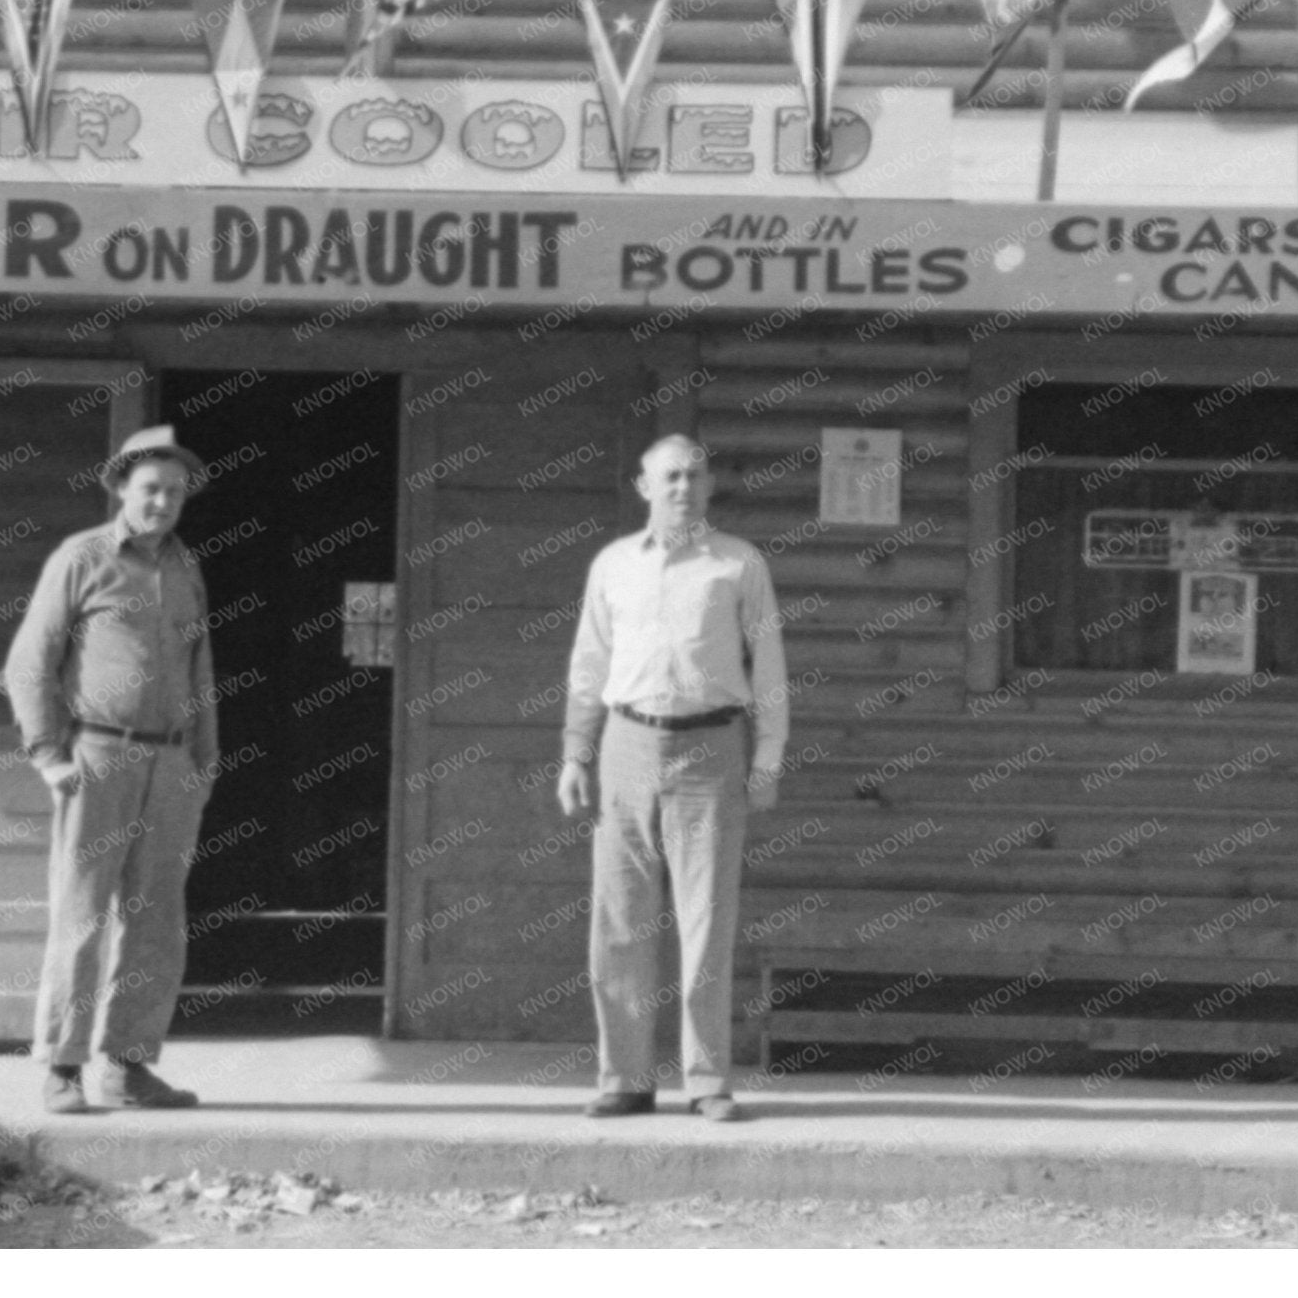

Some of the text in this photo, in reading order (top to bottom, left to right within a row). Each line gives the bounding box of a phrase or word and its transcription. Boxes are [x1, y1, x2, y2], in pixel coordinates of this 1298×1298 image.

[206, 94, 871, 174] COOLED
[104, 226, 189, 281] ON
[213, 205, 577, 289] DRAUGHT
[705, 213, 858, 241] AND IN
[620, 242, 969, 294] BOTTLES
